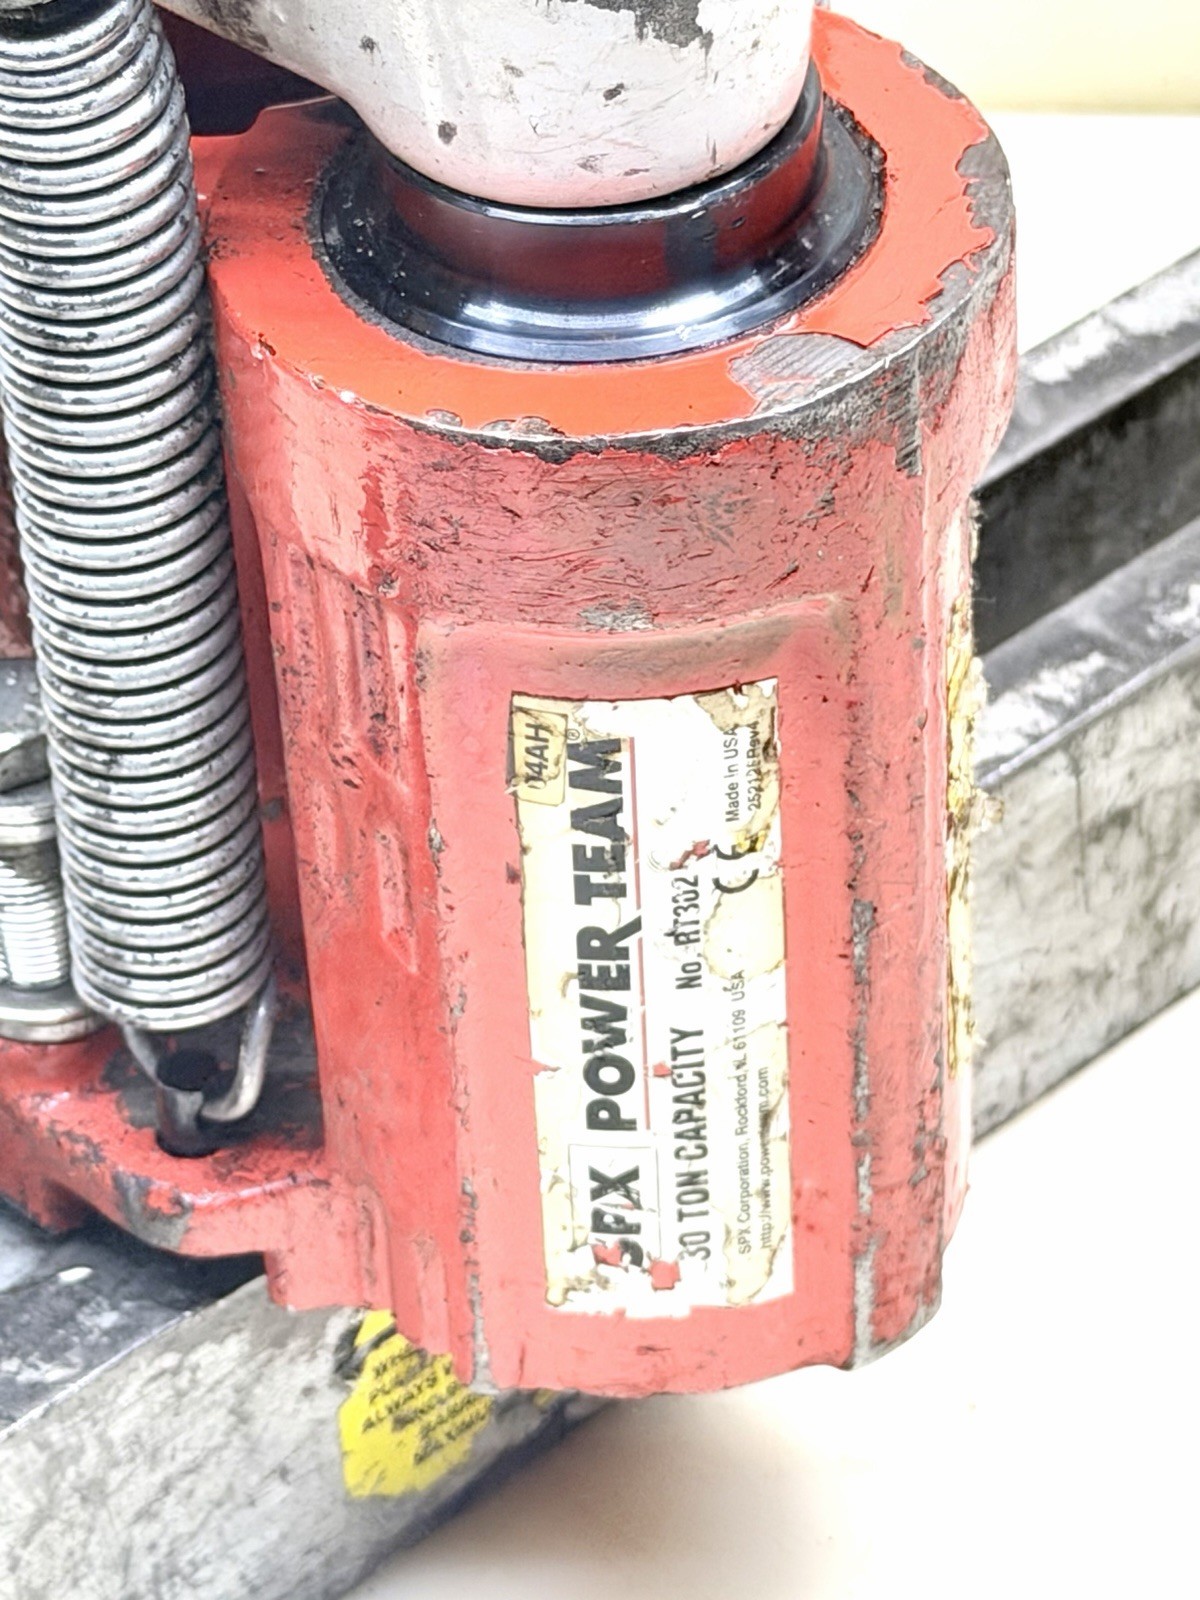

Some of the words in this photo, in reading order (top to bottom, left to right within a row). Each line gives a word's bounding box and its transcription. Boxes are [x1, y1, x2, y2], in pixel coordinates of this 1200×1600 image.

[723, 723, 738, 759] USA
[567, 737, 628, 906] TEAM
[725, 782, 740, 822] Made
[671, 875, 701, 946] RT302
[675, 952, 702, 989] No.
[732, 969, 745, 1000] USA
[576, 915, 642, 1131] POWER
[733, 1010, 746, 1050] 61109
[670, 1027, 708, 1160] CAPACITY
[737, 1138, 751, 1223] Corporation,
[758, 1067, 771, 1249] http://www.powertm.com
[676, 1169, 710, 1222] TON
[678, 1231, 711, 1260] 30
[738, 1224, 752, 1255] SPX
